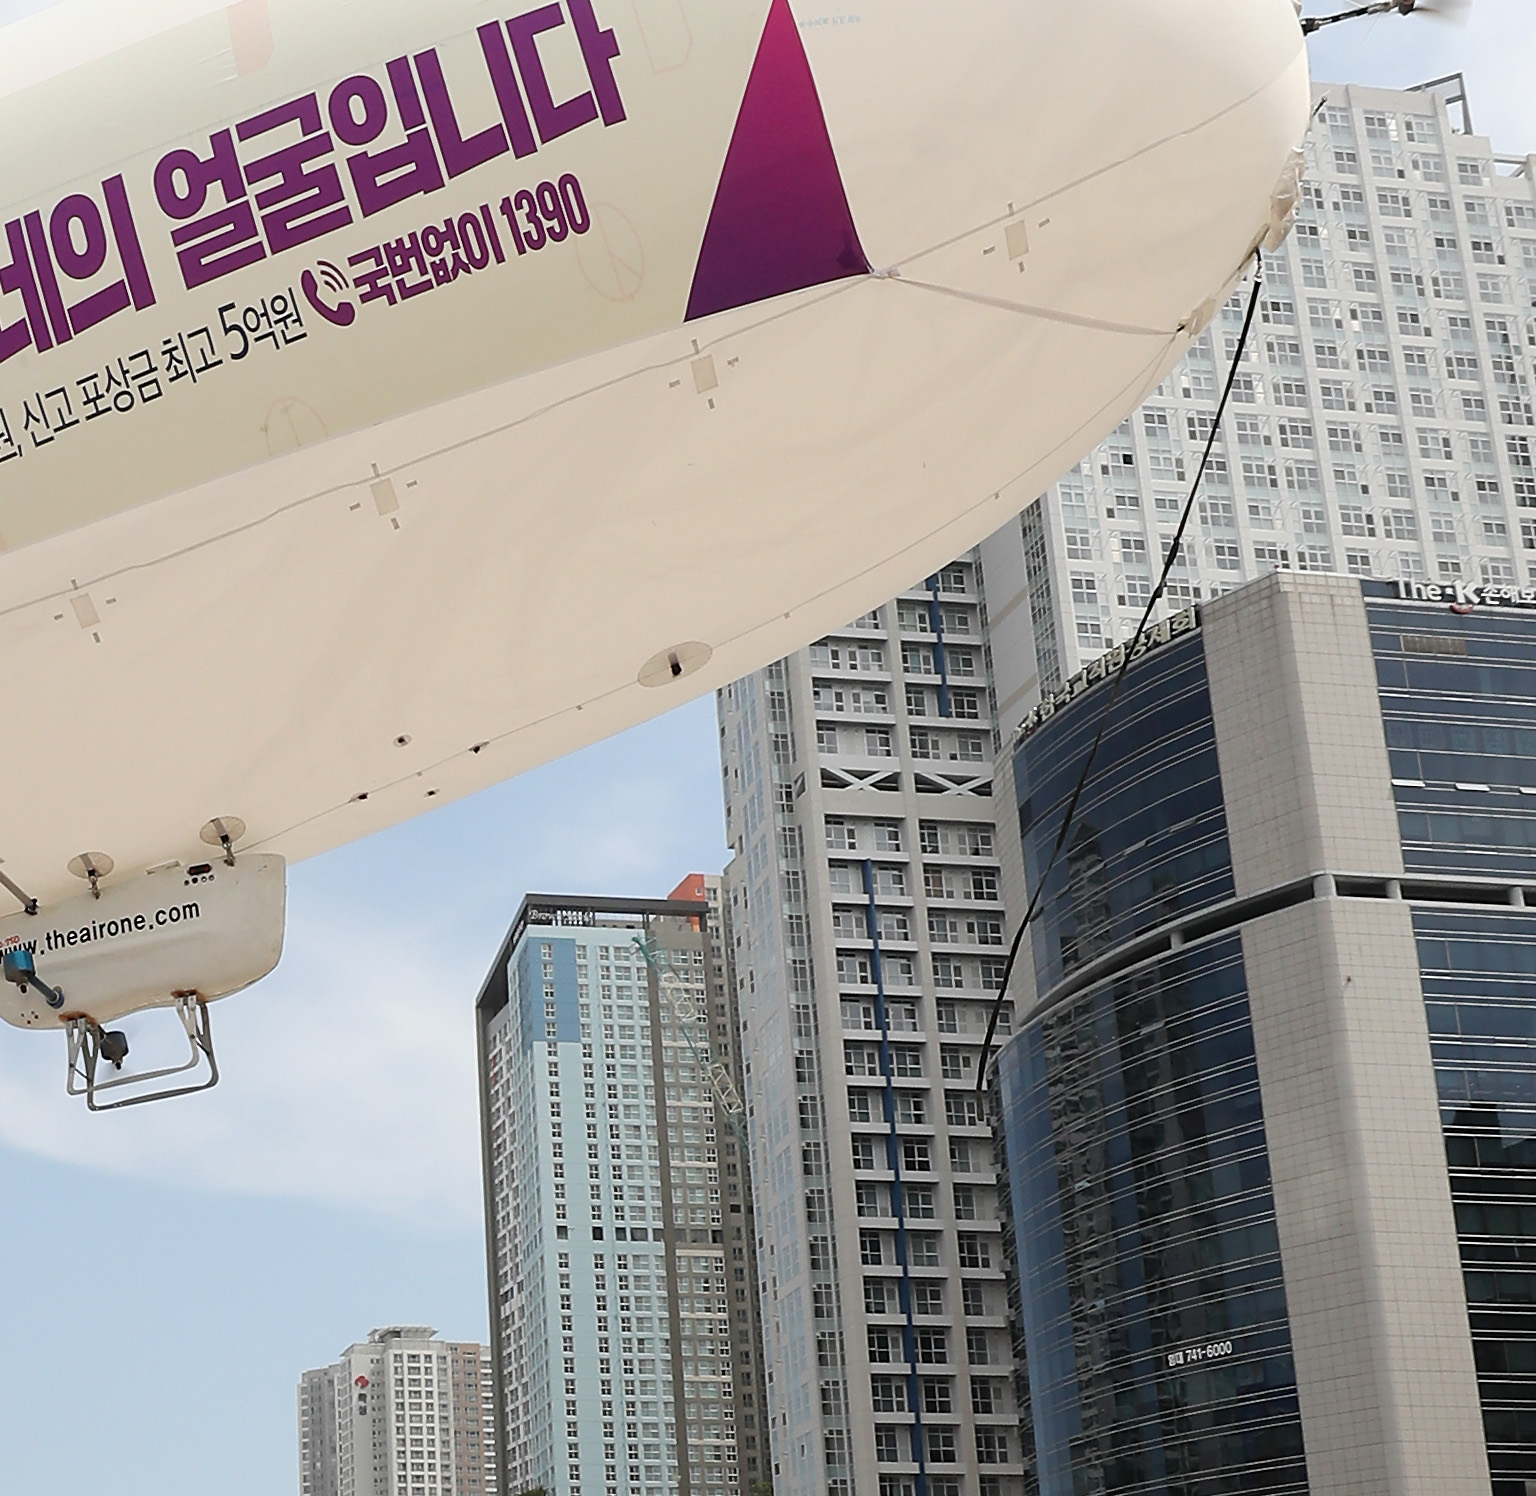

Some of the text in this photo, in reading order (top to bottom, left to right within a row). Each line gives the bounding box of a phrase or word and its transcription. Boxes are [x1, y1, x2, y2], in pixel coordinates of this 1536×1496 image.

[346, 172, 592, 307] 국번없이 1390
[22, 386, 80, 449] 신고
[75, 349, 164, 422] 포상금
[161, 325, 224, 385] 최고
[217, 286, 308, 363] 5억원
[1168, 1341, 1232, 1367] 임대 741-6000
